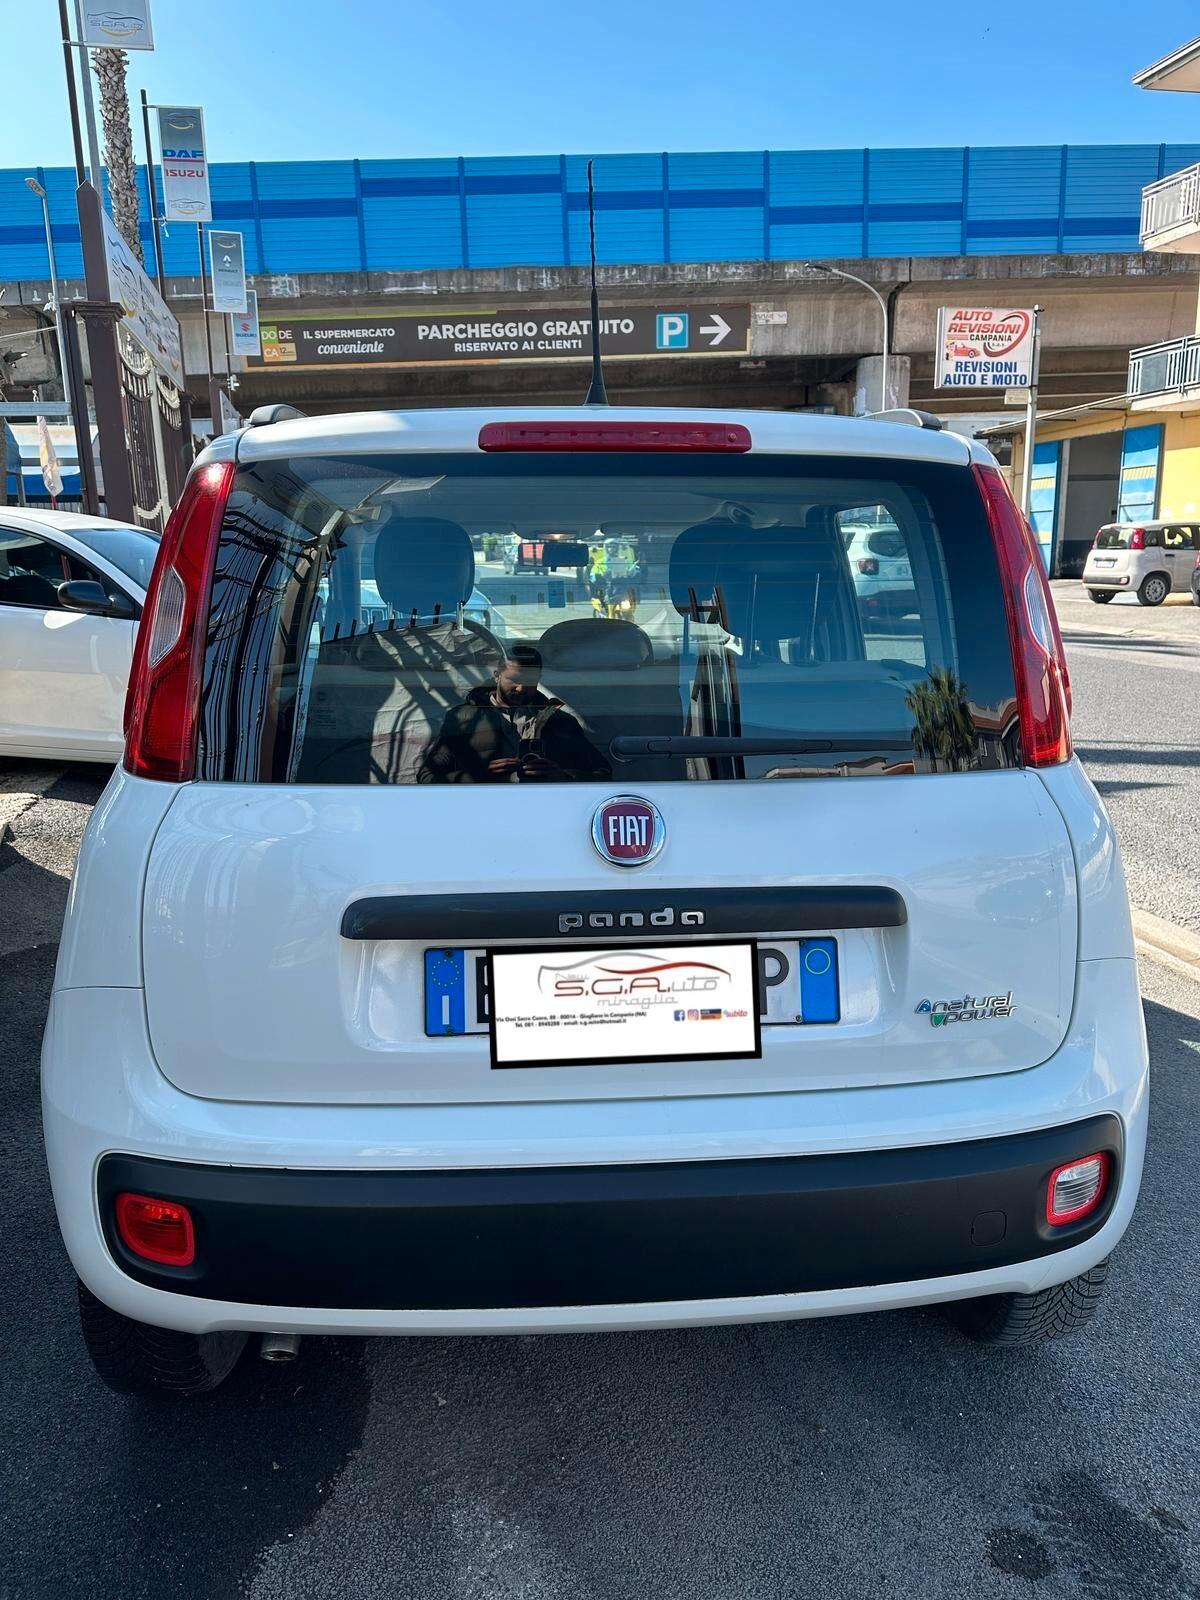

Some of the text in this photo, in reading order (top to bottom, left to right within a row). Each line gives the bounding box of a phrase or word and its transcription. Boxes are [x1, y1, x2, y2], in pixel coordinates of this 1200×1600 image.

[162, 149, 204, 158] DAF
[165, 169, 204, 178] ISUZU
[952, 311, 993, 321] AUTO
[279, 330, 293, 339] DE
[303, 328, 396, 339] IL SUPERMERCATO
[417, 321, 538, 340] PARCHEGGIO
[662, 316, 683, 346] P
[948, 322, 1021, 334] REVISIONI
[318, 341, 384, 354] conveniente
[454, 339, 582, 352] RISERVATO AI CLIENTI
[955, 361, 1017, 373] REVISIONI
[944, 373, 1027, 386] AUTO E MOTO
[608, 815, 649, 846] FIAT
[558, 907, 704, 933] panda
[932, 990, 1014, 1012] natural
[943, 1006, 1018, 1025] power
